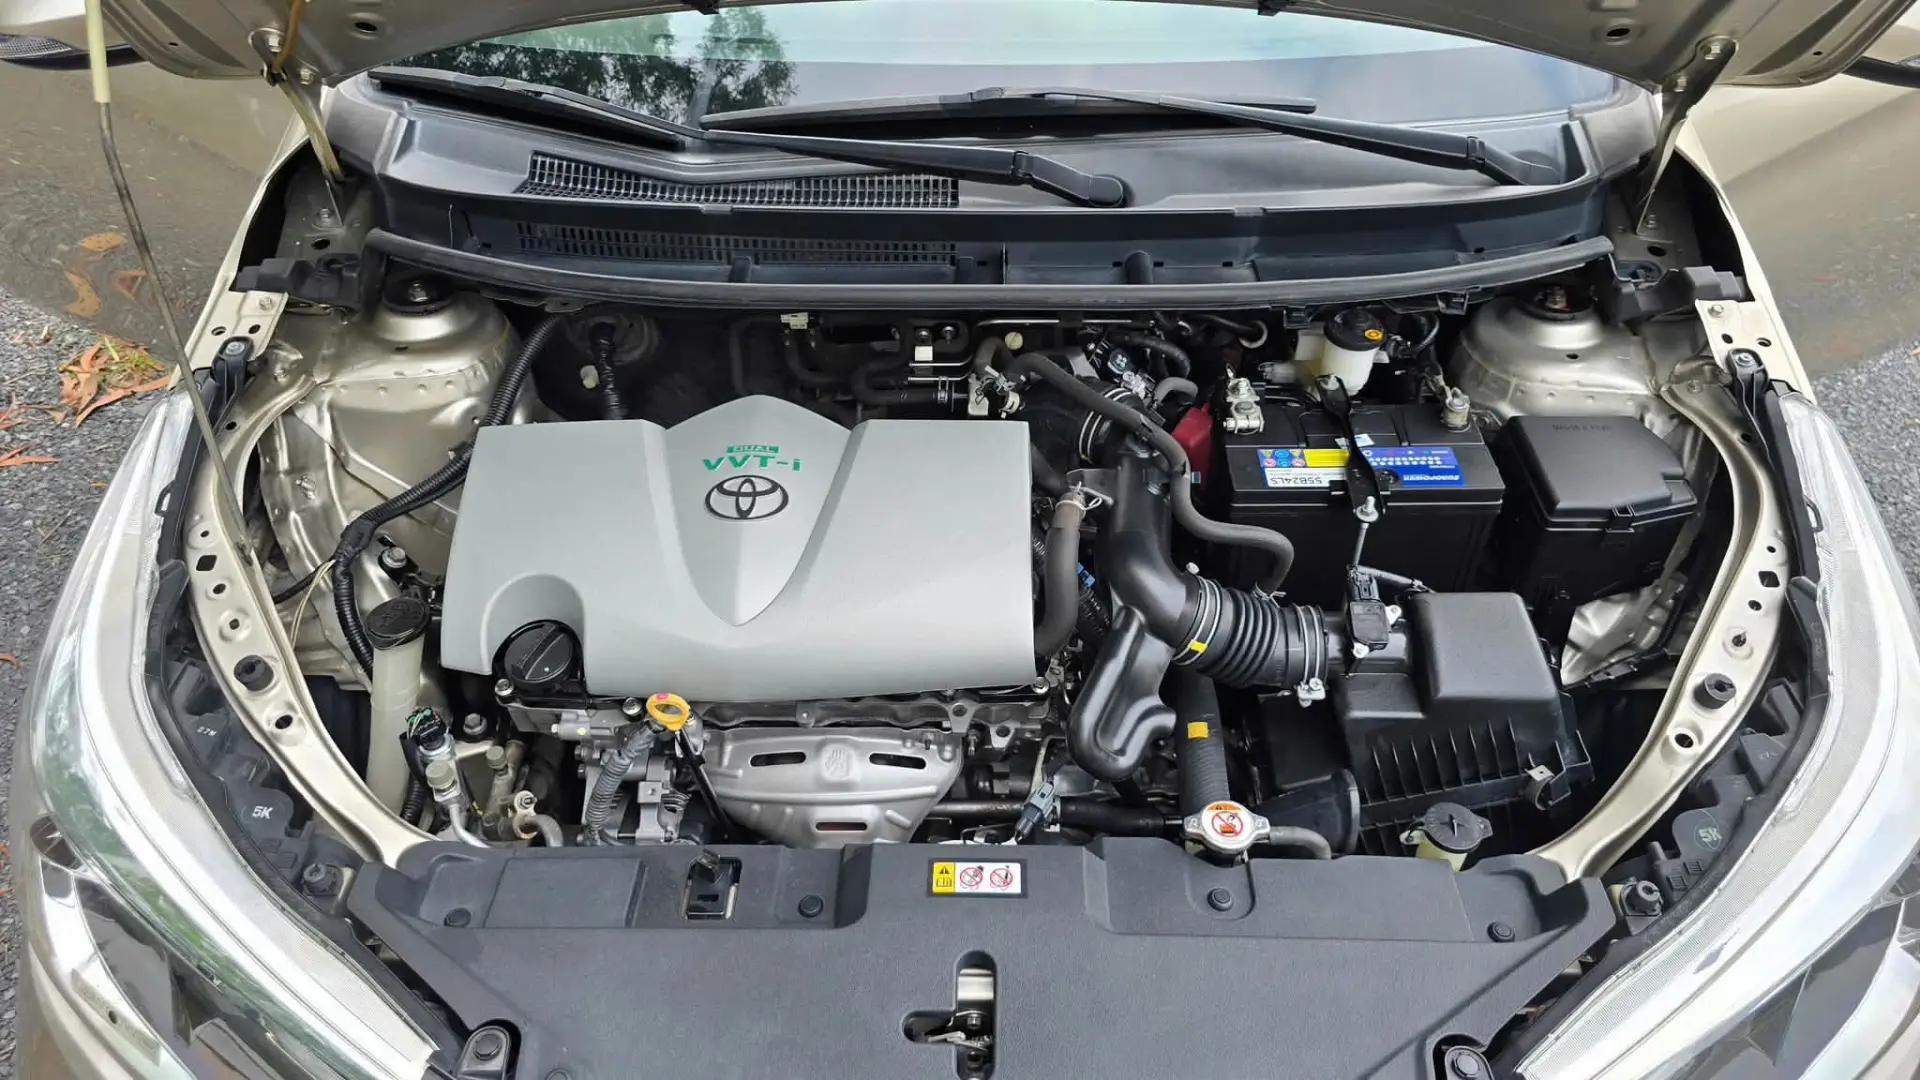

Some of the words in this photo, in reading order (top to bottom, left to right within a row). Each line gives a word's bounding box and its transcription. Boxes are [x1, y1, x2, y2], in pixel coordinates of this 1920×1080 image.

[731, 445, 775, 453] DUAL
[702, 455, 801, 471] VVT-i
[252, 805, 274, 819] 5K
[1698, 827, 1723, 842] 5K
